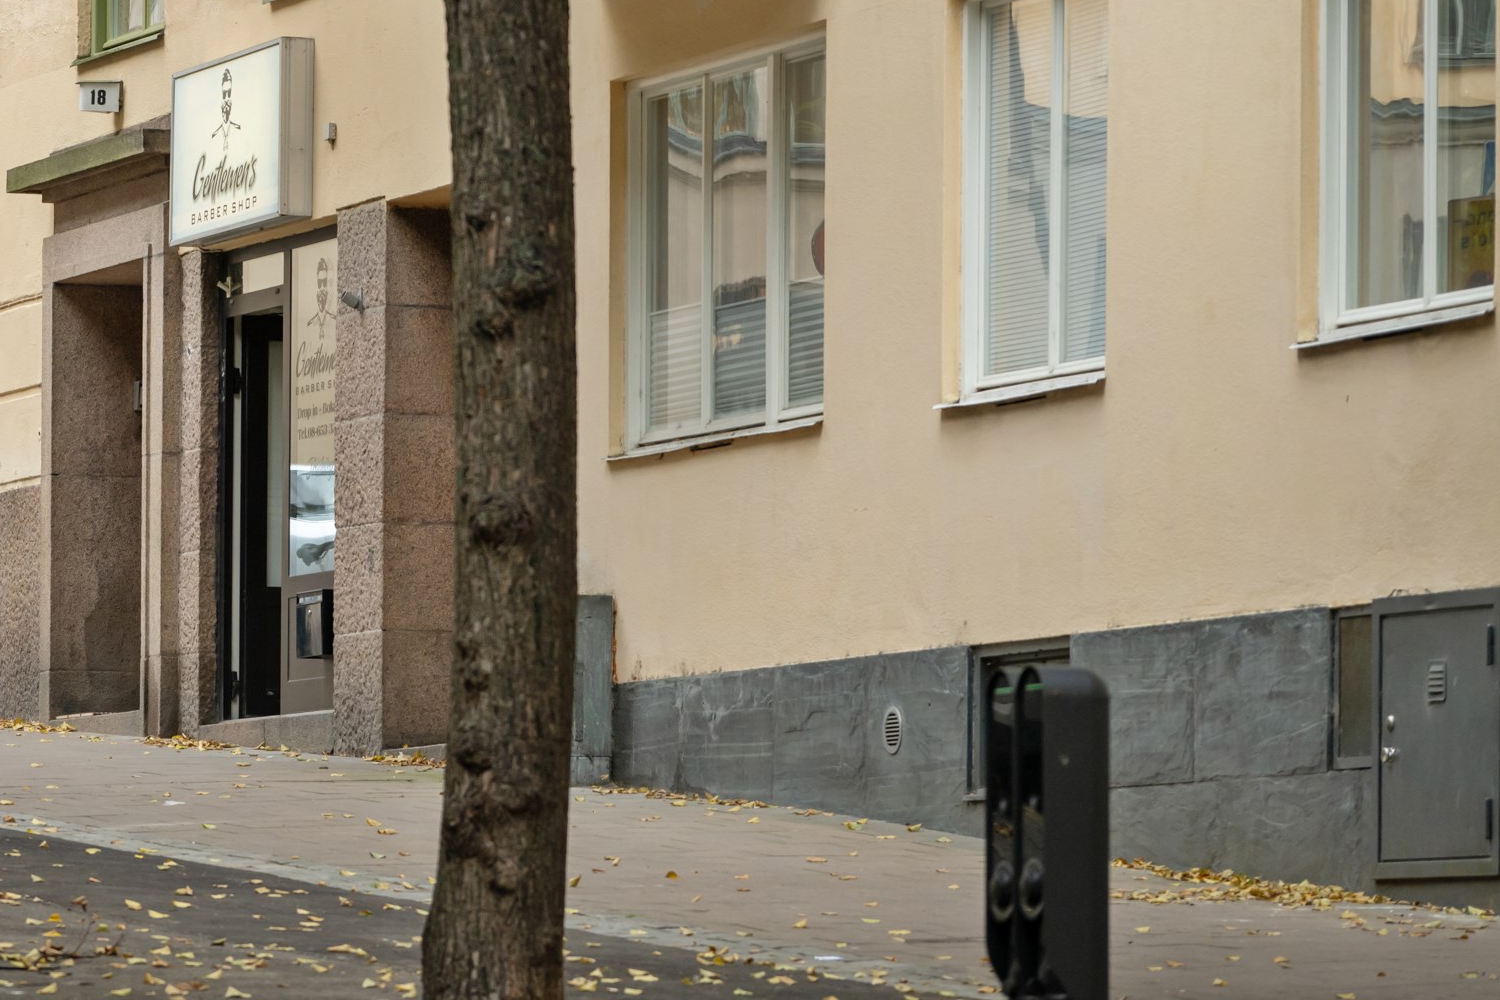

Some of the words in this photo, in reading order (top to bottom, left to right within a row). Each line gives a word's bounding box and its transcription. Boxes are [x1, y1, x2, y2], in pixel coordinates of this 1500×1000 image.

[90, 89, 106, 105] 18
[192, 153, 257, 203] Gentlemen's
[191, 204, 228, 226] BARBER
[231, 195, 257, 214] SHOP
[295, 381, 325, 396] BARBER
